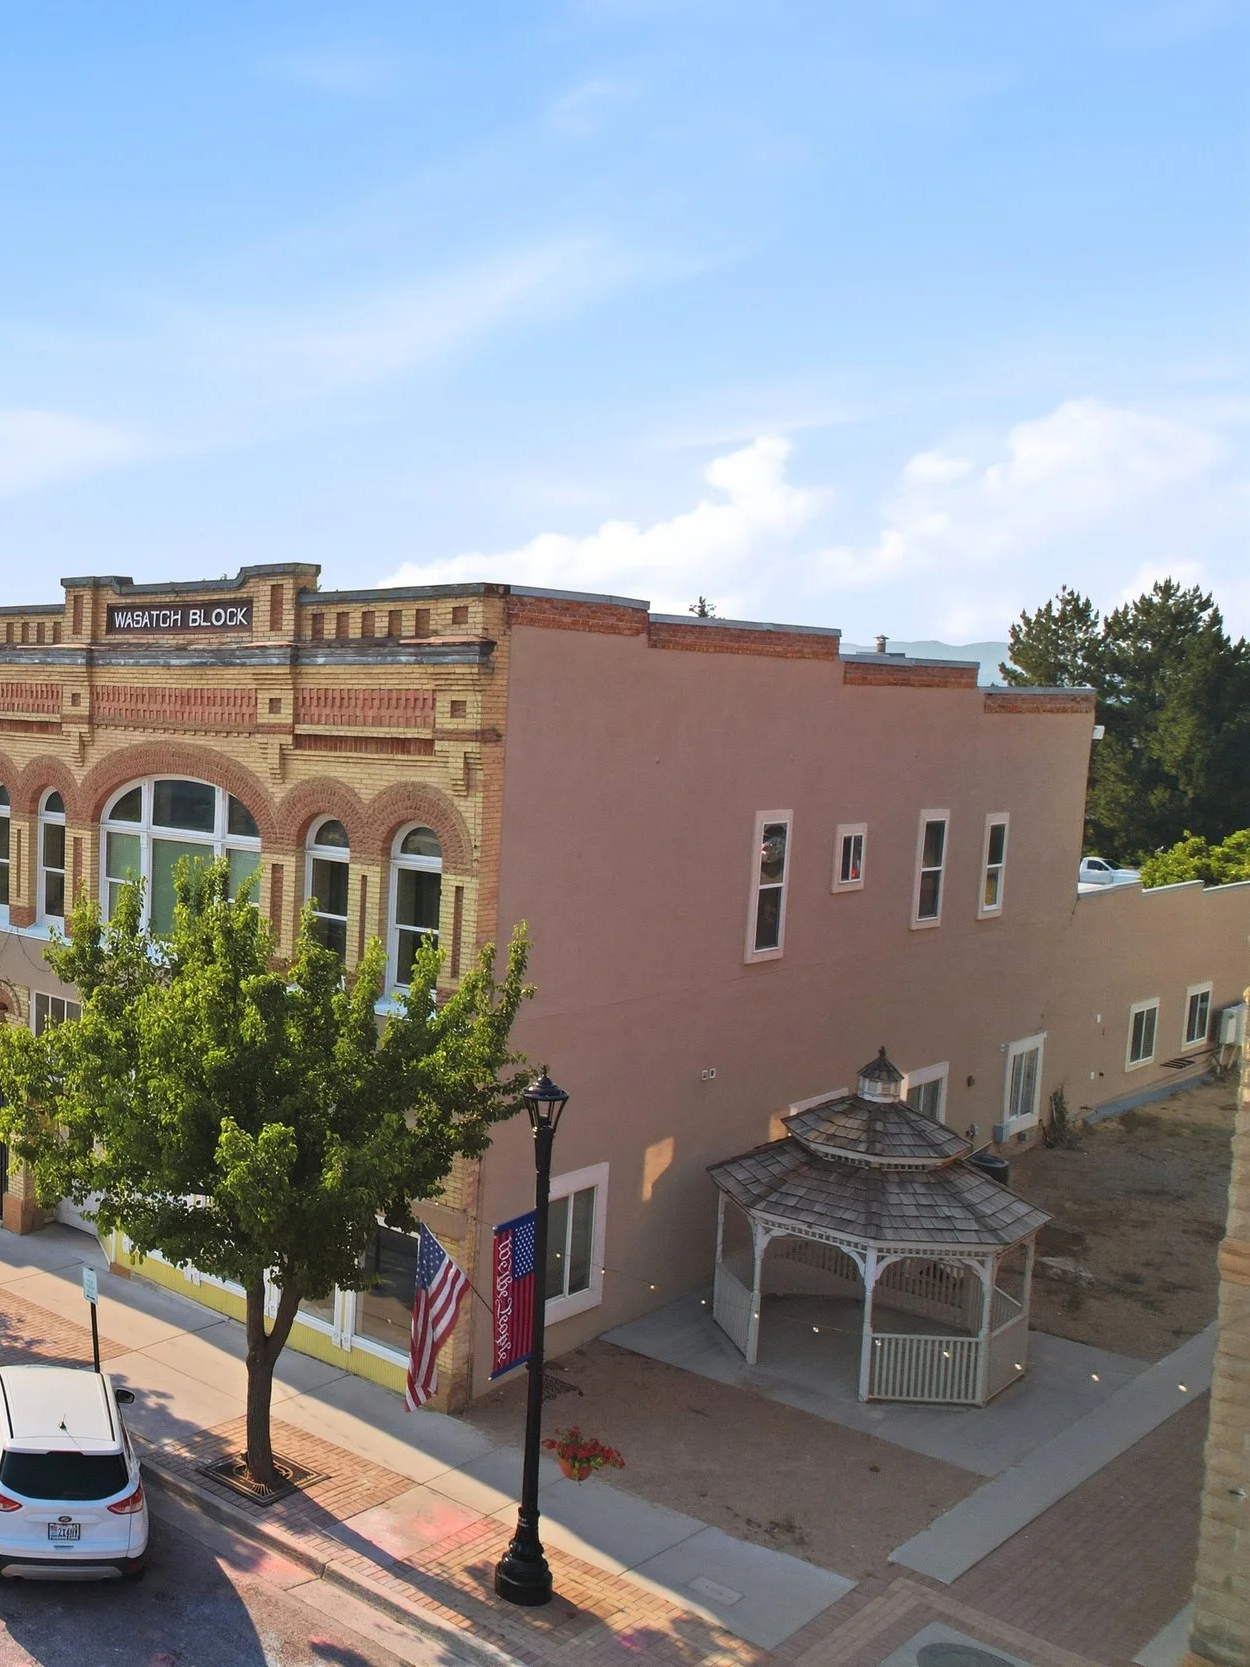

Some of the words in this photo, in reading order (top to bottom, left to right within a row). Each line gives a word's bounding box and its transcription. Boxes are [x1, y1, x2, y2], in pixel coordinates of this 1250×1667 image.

[114, 609, 182, 628] WASATCH
[189, 607, 248, 626] BLOCK
[498, 1235, 512, 1273] We
[495, 1298, 513, 1363] People
